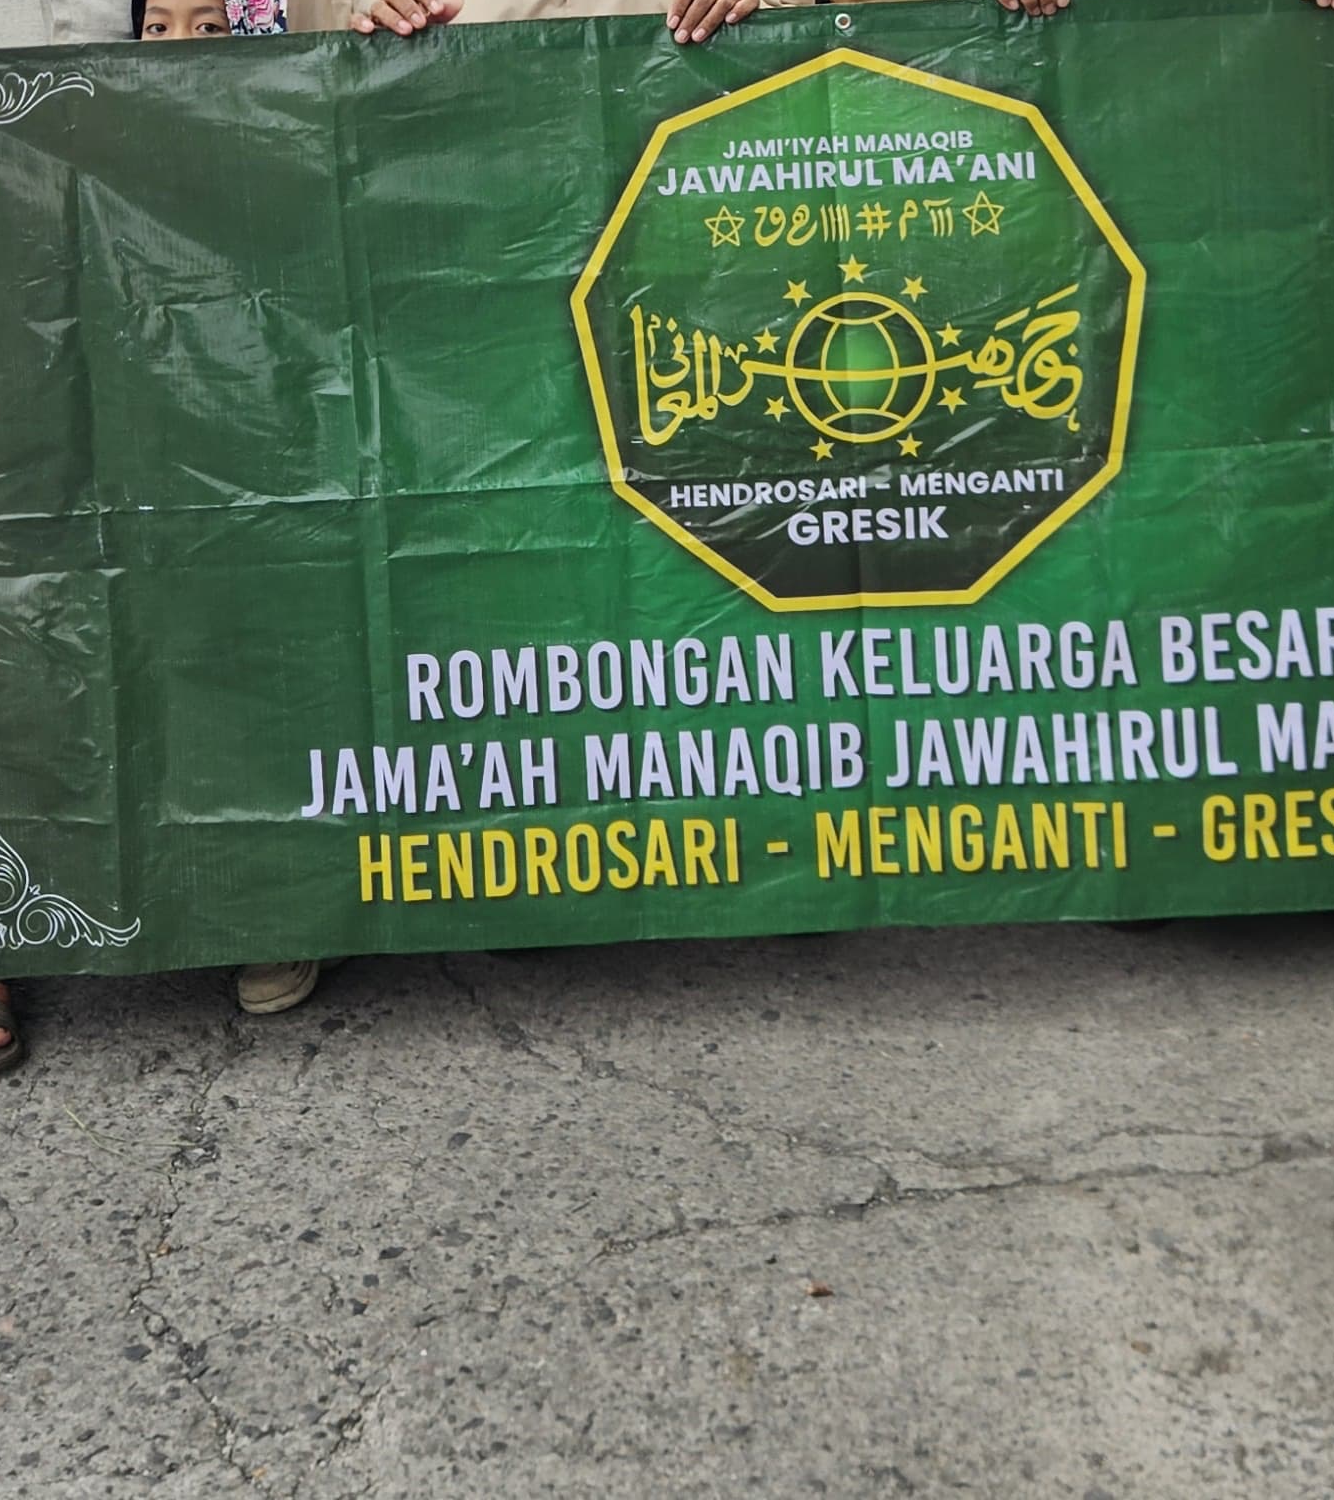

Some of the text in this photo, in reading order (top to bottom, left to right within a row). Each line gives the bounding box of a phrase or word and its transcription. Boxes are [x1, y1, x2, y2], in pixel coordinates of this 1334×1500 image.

[854, 129, 973, 154] MANAQIB
[657, 152, 1036, 195] JAWAHIRUL MA'ANI
[670, 476, 867, 508] HENDROSARI
[899, 467, 1064, 498] MENGANTI
[787, 505, 949, 546] GRESIK
[406, 632, 793, 721] ROMBONGAN
[820, 620, 1137, 698] KELUARGA
[301, 737, 557, 818] JAMA'AH
[584, 722, 863, 801] MANAQIB
[886, 706, 1238, 787] JAWAHIRUL
[359, 817, 739, 902] HENDROSARI
[816, 802, 1126, 878] MENGANTI
